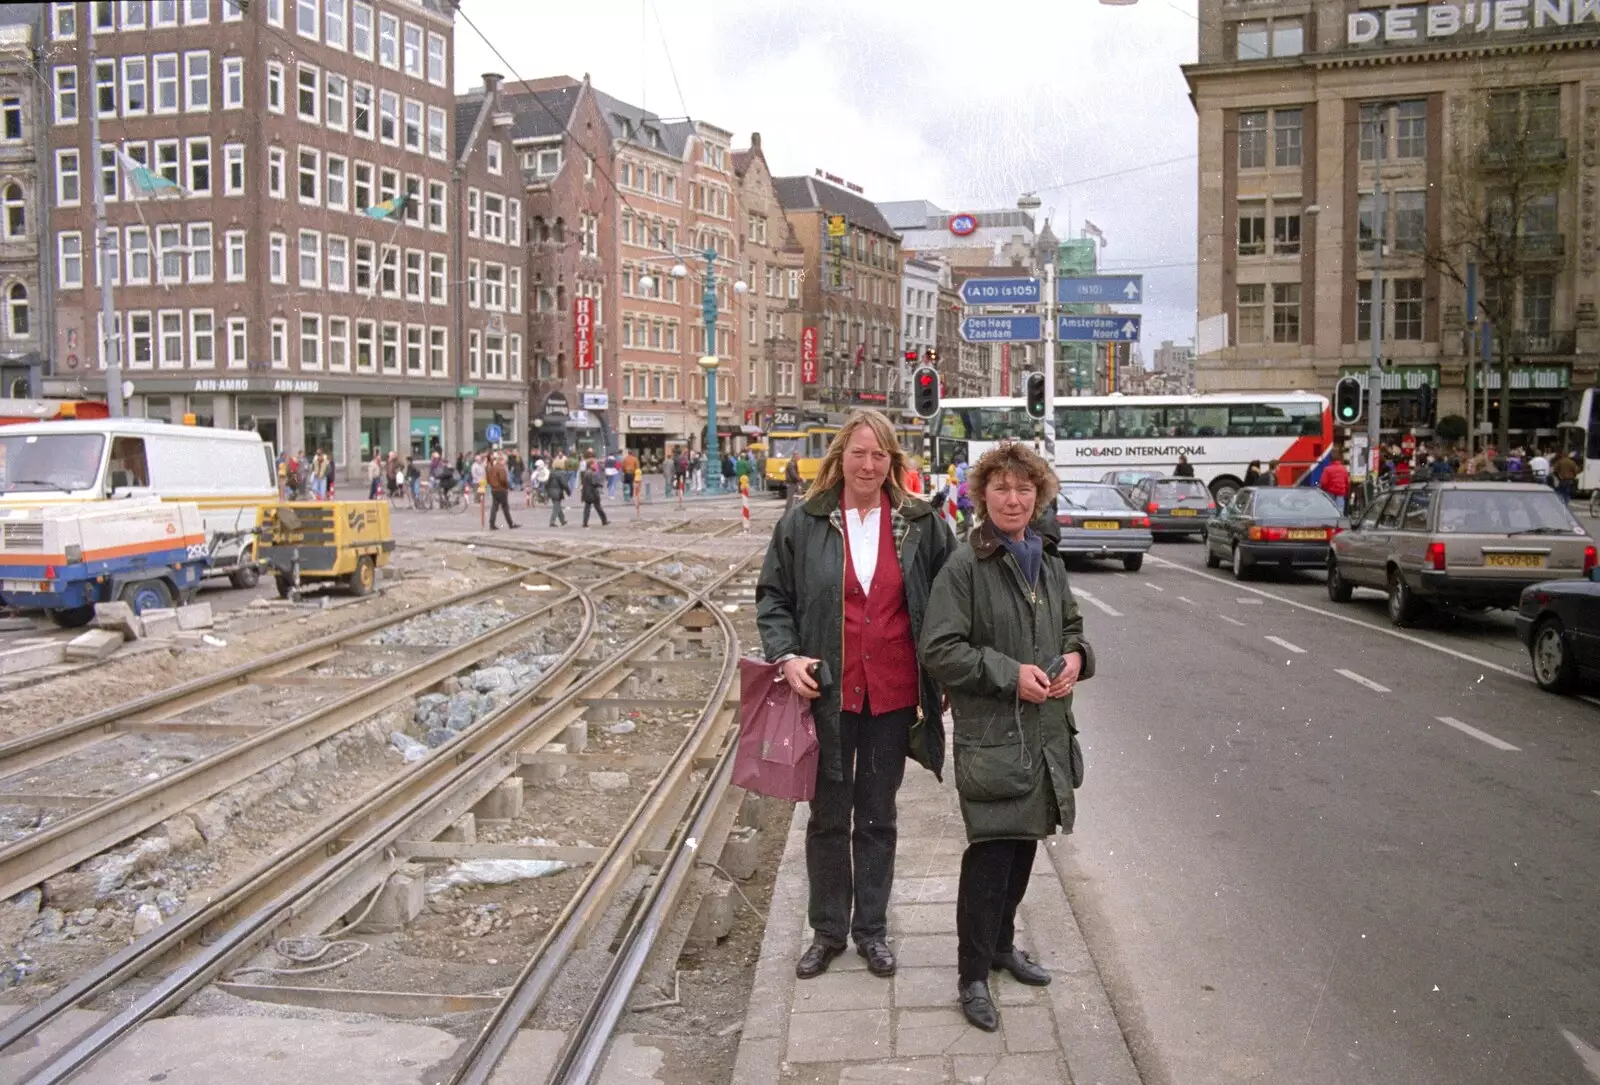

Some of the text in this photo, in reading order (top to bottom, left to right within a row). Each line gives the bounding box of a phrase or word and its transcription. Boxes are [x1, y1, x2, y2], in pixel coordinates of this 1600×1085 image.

[1347, 7, 1418, 44] DE
[968, 318, 1012, 329] Den Haag
[576, 299, 590, 368] HOTEL
[968, 329, 1012, 339] Zaandam
[1092, 329, 1120, 339] Noord
[803, 329, 814, 383] ASCOT
[1075, 445, 1206, 456] HOLLAND INTERNATIONAL
